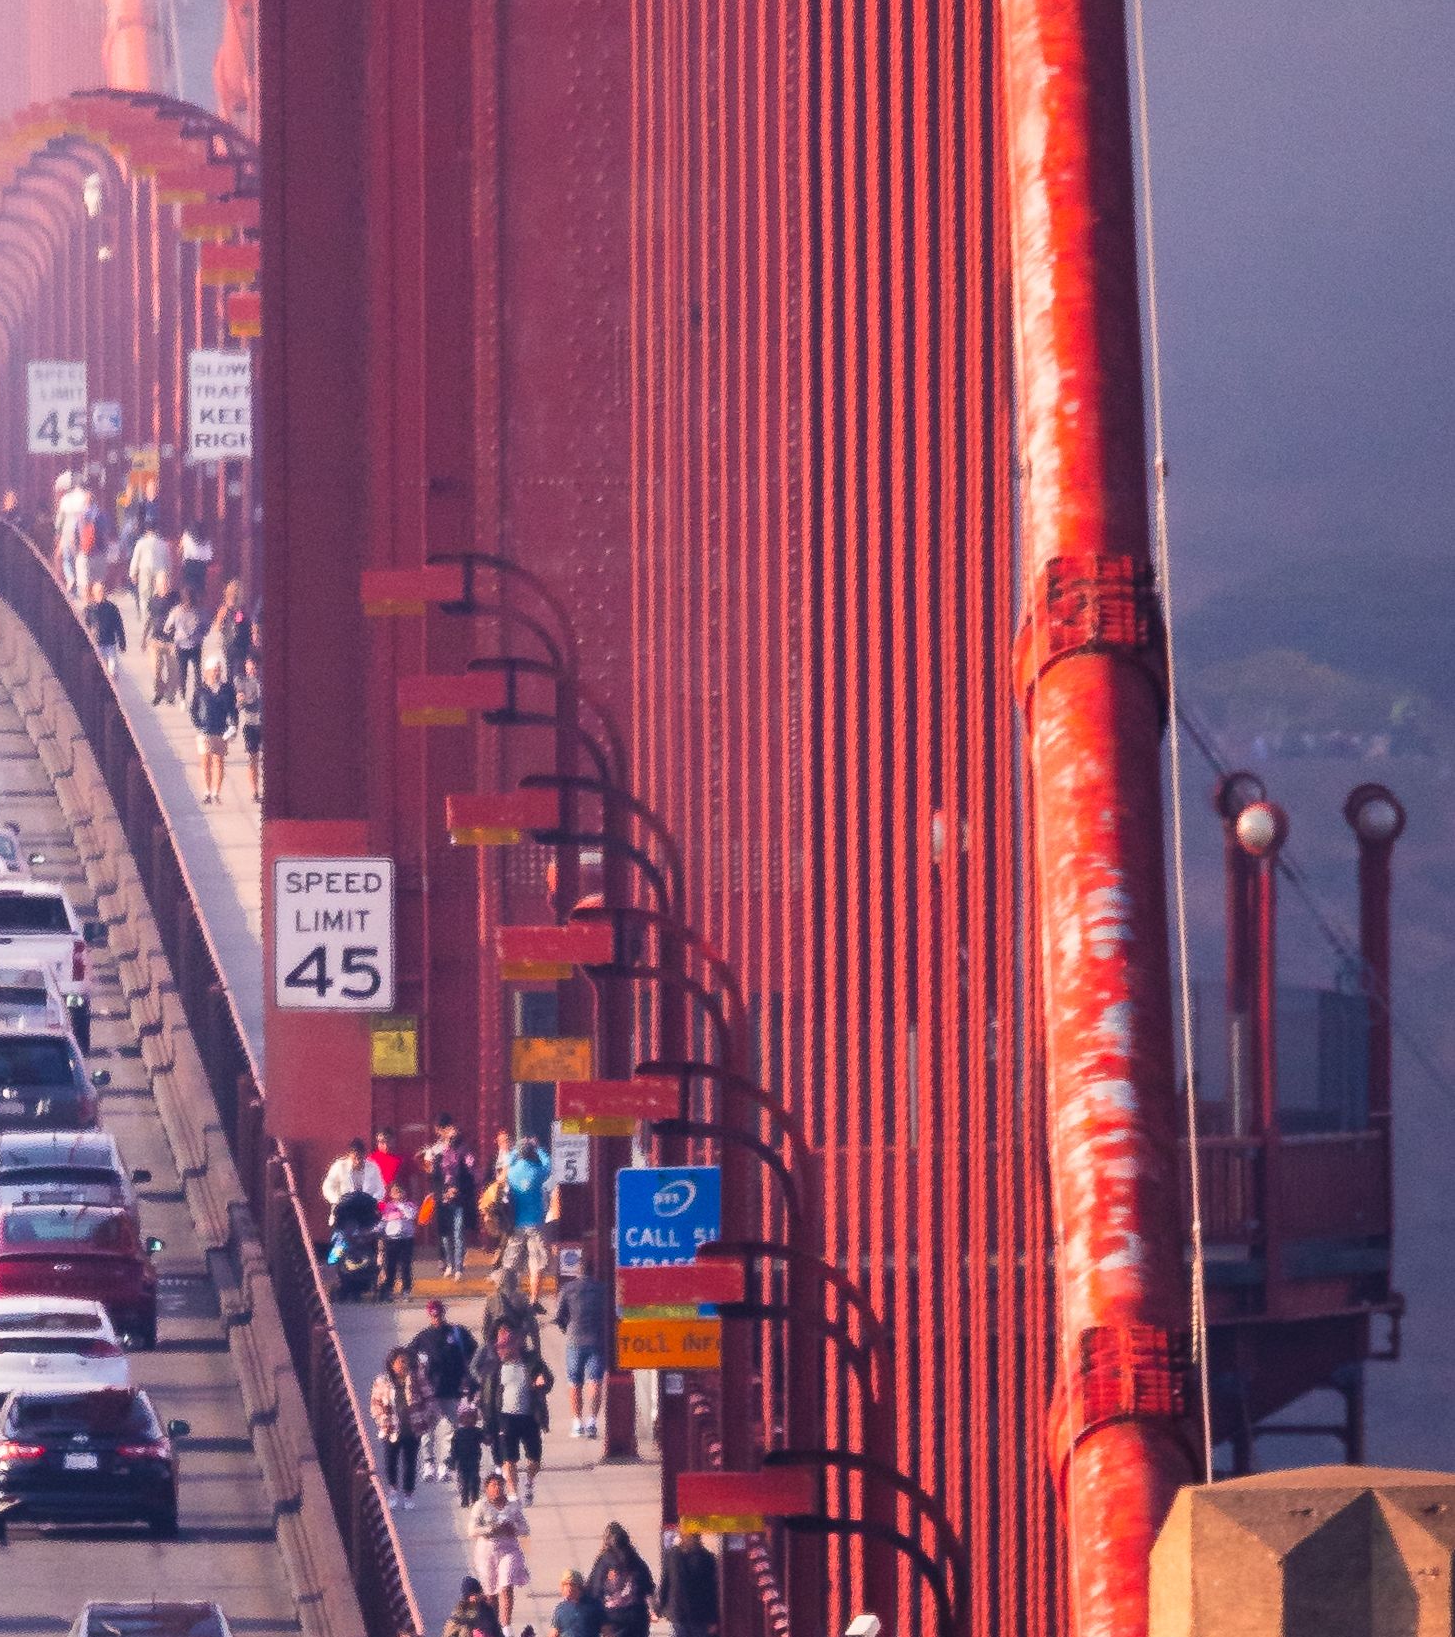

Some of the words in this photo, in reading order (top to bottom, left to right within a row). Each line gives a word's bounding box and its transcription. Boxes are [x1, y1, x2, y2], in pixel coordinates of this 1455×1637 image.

[37, 410, 87, 446] 45
[285, 872, 382, 894] SPEED
[295, 909, 371, 933] LIMIT
[285, 942, 382, 1000] 45
[564, 1159, 578, 1181] 5
[625, 1227, 681, 1248] CALL
[617, 1335, 670, 1352] TOLL
[683, 1334, 720, 1352] INF
